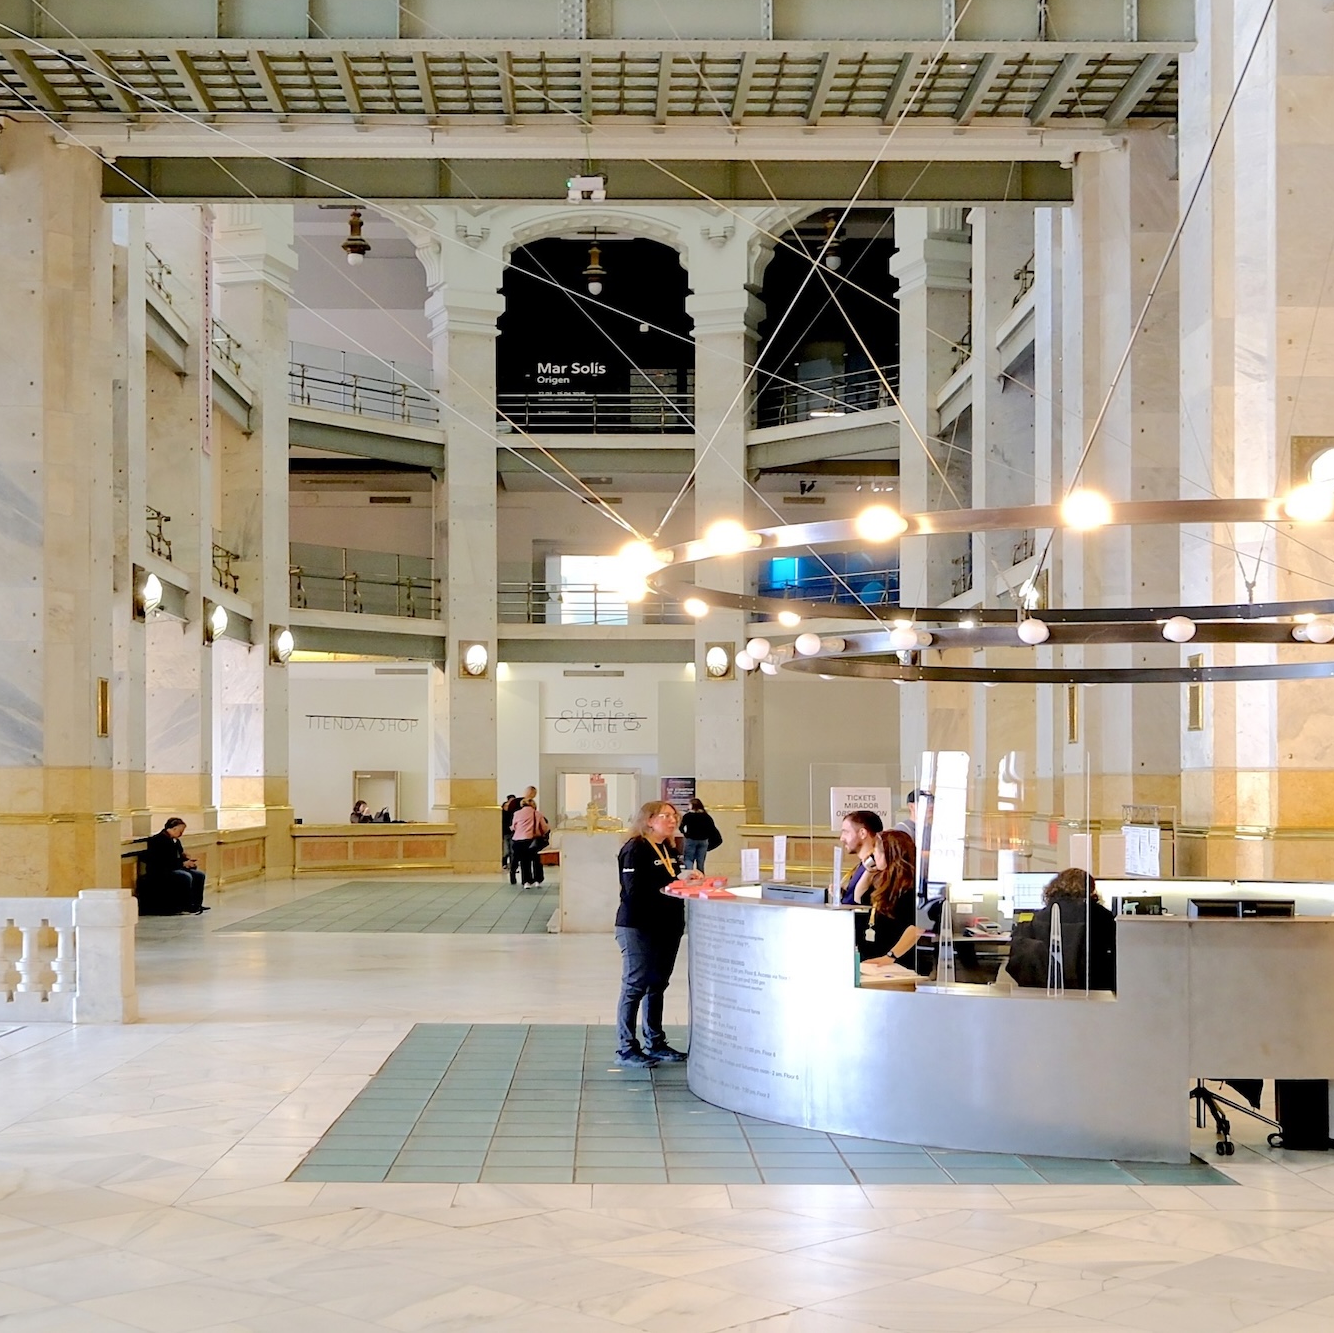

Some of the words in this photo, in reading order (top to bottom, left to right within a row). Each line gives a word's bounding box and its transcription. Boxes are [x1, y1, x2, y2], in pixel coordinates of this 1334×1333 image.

[537, 363, 568, 374] Mar
[571, 362, 606, 374] Solís
[537, 376, 570, 385] Origen
[575, 697, 623, 707] Café
[560, 709, 637, 720] Cibeles
